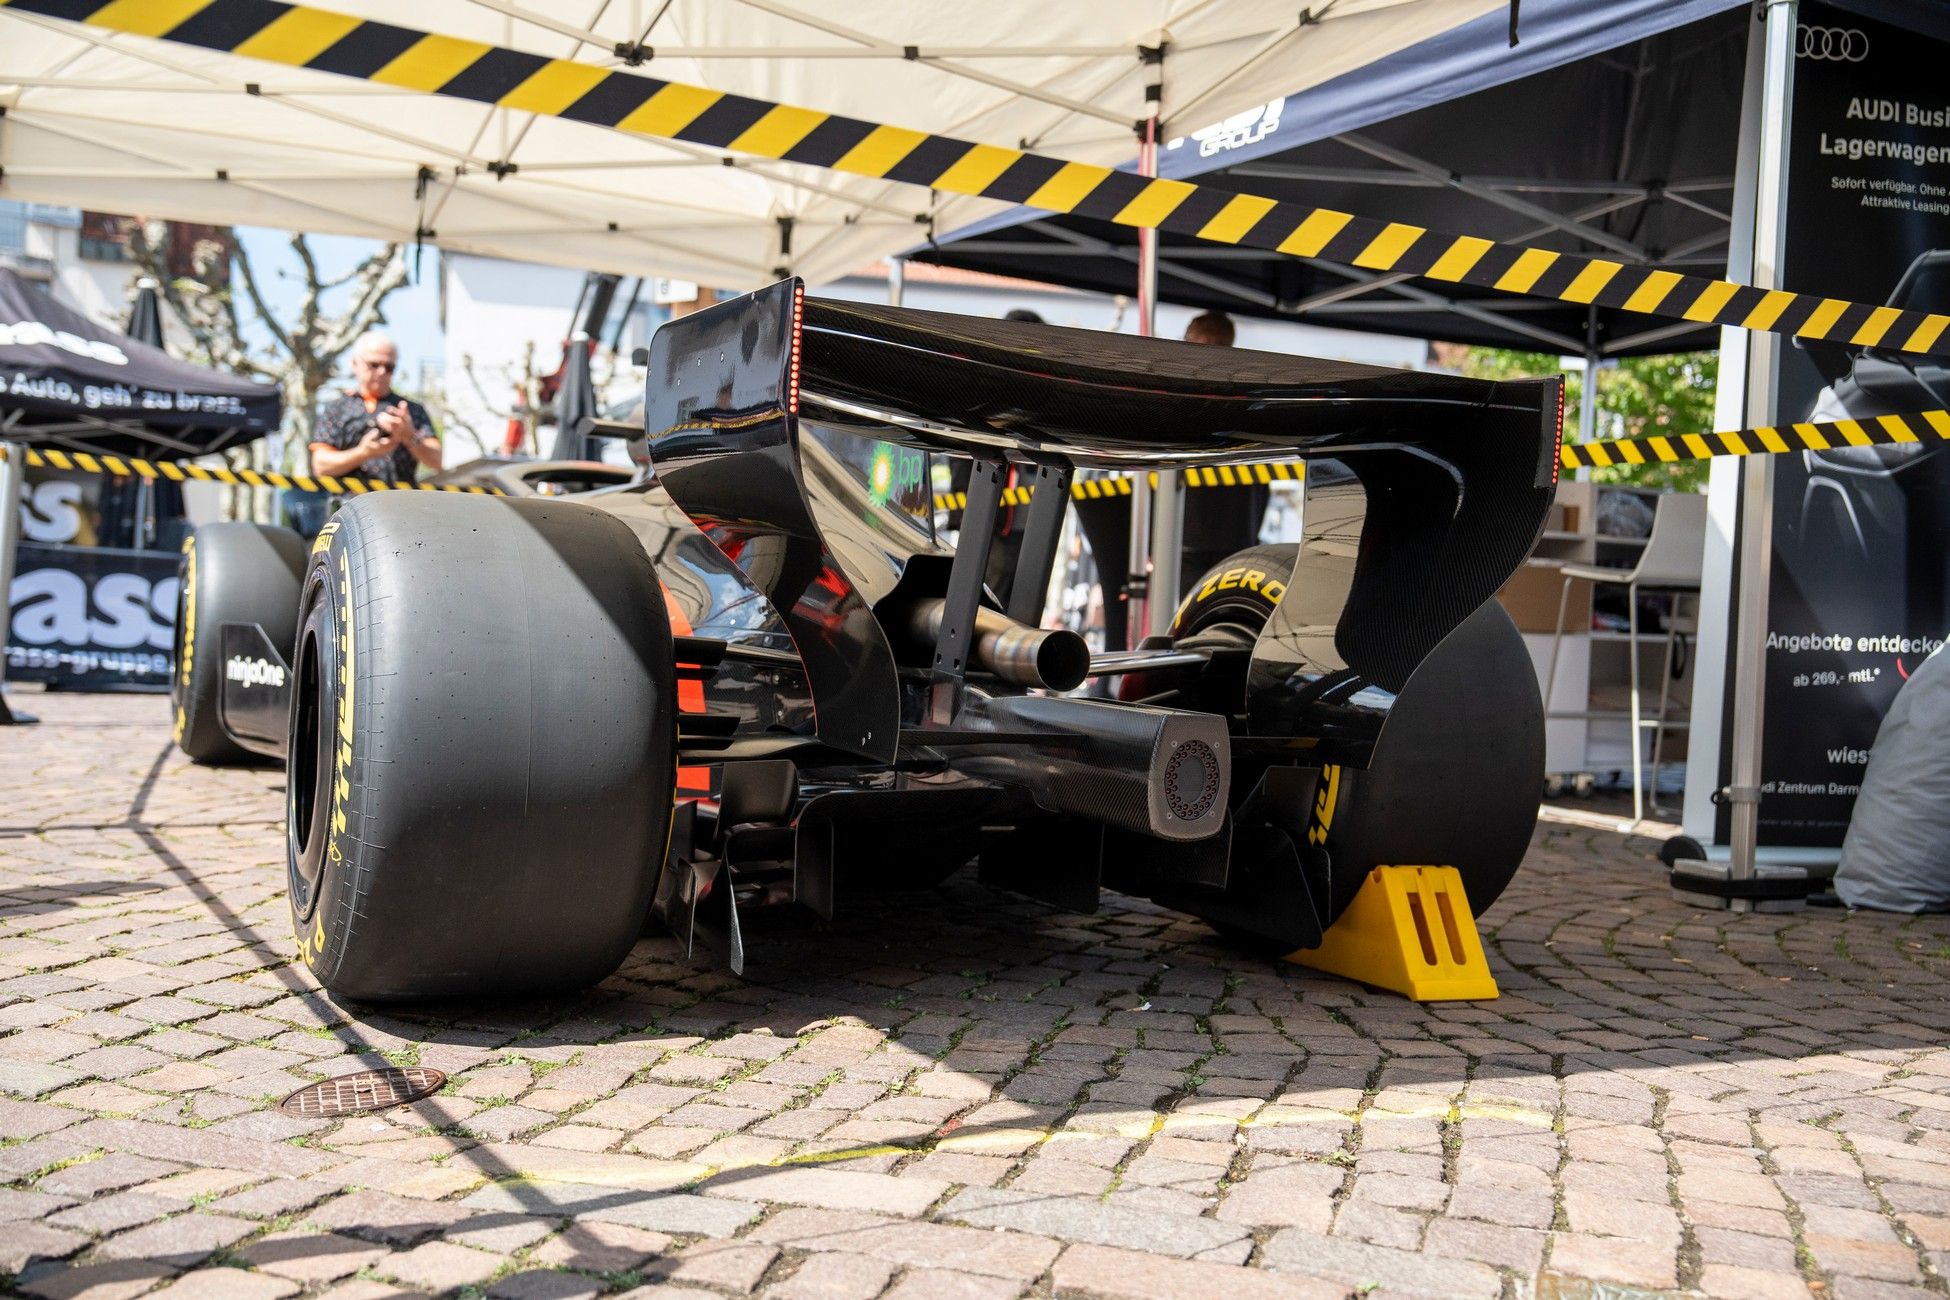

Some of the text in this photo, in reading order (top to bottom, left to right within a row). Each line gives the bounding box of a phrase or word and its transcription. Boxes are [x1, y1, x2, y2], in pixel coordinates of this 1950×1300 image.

[1846, 97, 1950, 127] AUDI Busi
[1200, 118, 1281, 157] GROUP
[1820, 132, 1950, 166] Lagerwagen
[1831, 176, 1946, 196] Sofort verfügbar. Ohne
[1861, 194, 1950, 215] Attraktive Leasing
[142, 391, 173, 409] zu
[900, 448, 923, 493] bp
[1196, 568, 1287, 605] ZERO
[1766, 631, 1853, 653] Angebote
[1793, 673, 1809, 687] ab
[1812, 671, 1845, 685] 269,-
[1827, 746, 1872, 765] wies
[1778, 781, 1826, 795] Zentrum
